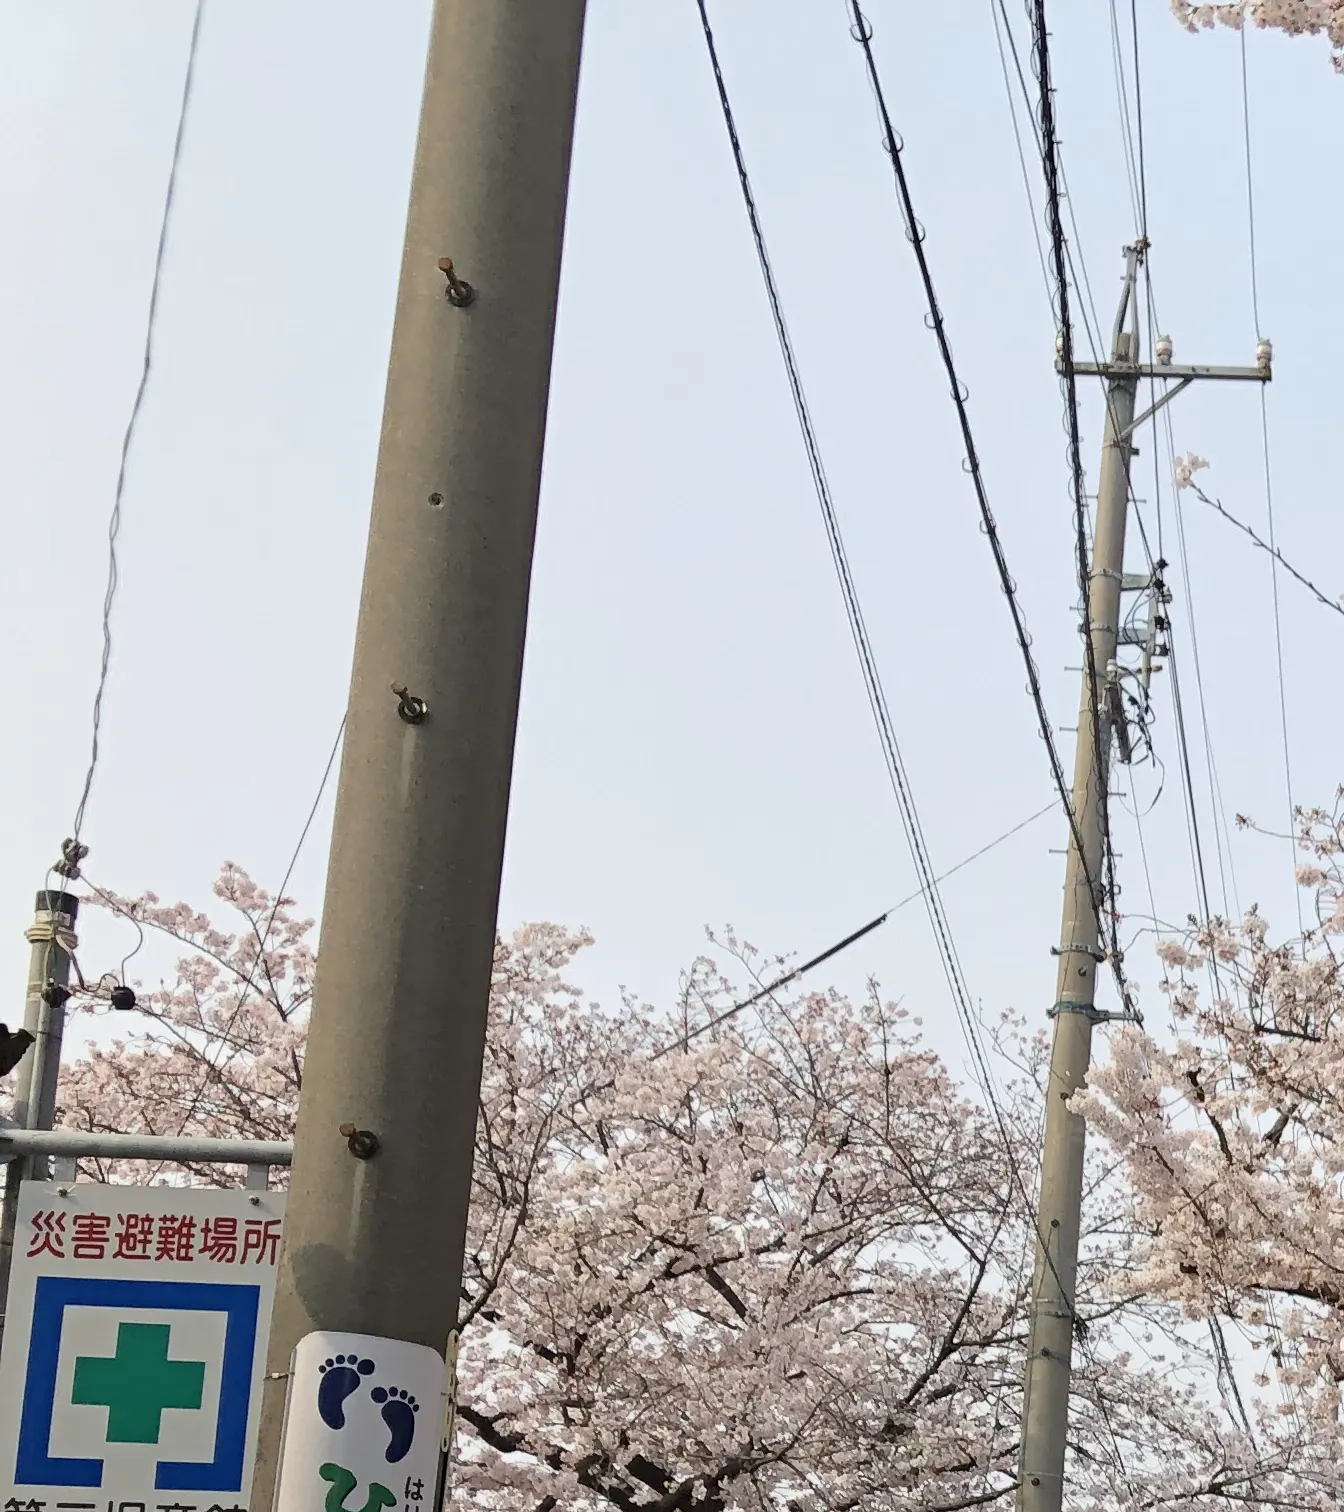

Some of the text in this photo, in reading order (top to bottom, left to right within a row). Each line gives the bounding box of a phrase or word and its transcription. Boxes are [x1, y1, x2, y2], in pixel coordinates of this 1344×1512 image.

[26, 1209, 282, 1266] 災害避難場所
